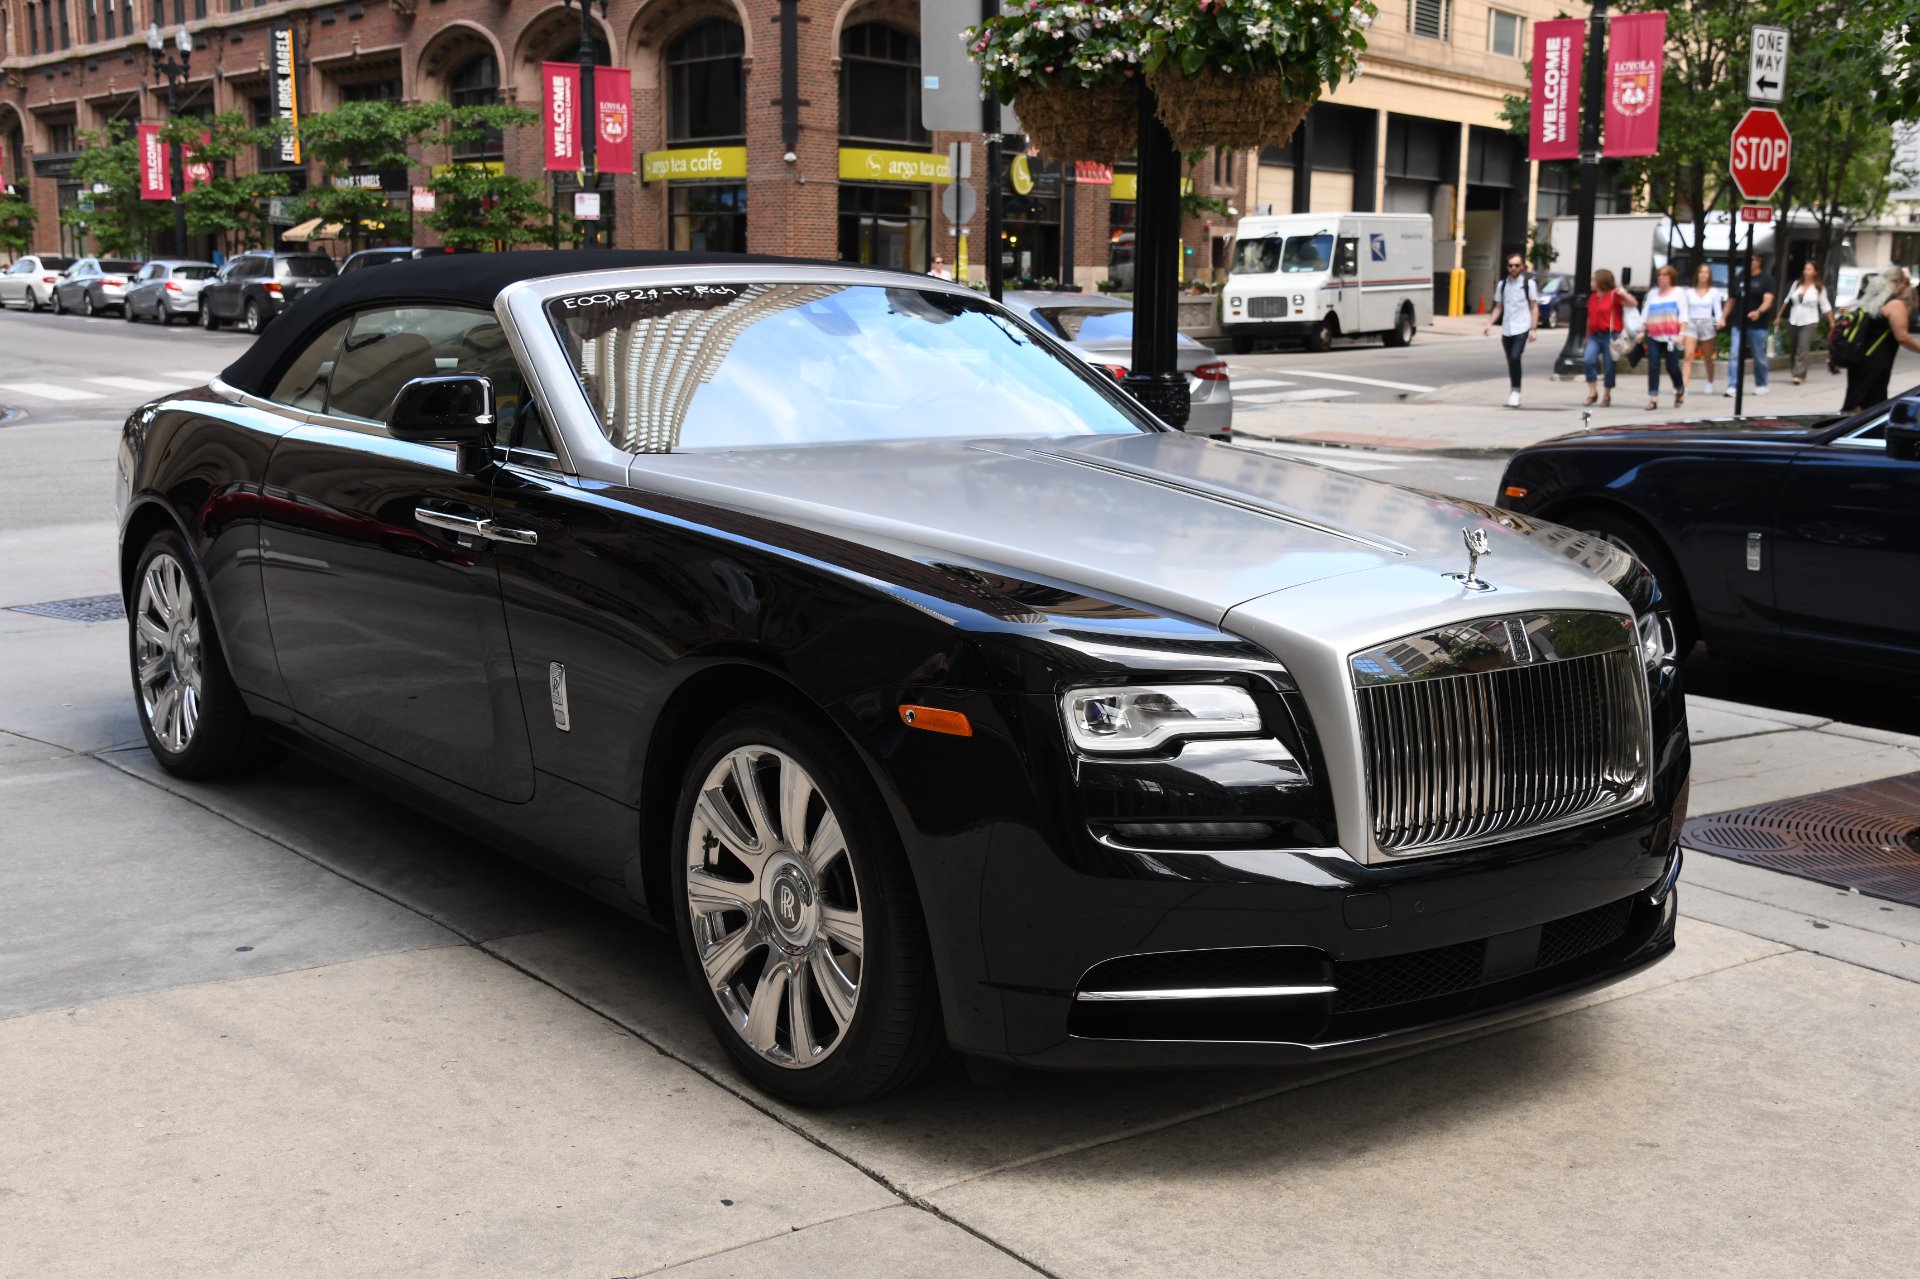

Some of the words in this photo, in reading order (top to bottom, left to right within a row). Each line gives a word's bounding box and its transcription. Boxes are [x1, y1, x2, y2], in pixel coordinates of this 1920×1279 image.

[275, 30, 290, 74] BAGELS
[1561, 37, 1571, 76] CAMPUS
[1757, 33, 1783, 52] ONE
[1614, 60, 1655, 72] LOYOLA
[1755, 54, 1783, 72] WAY
[1543, 37, 1561, 143] WELCOME
[1559, 77, 1569, 111] TOWER
[552, 76, 566, 157] WELCOME
[1558, 111, 1567, 143] WATER
[146, 133, 158, 190] WELCOME
[671, 157, 688, 172] tea
[689, 149, 723, 172] café
[889, 161, 918, 179] argo
[920, 161, 934, 176] tea
[1734, 136, 1787, 171] STOP
[1743, 209, 1756, 219] ALL
[1757, 209, 1770, 220] WAY
[780, 885, 796, 922] RR
